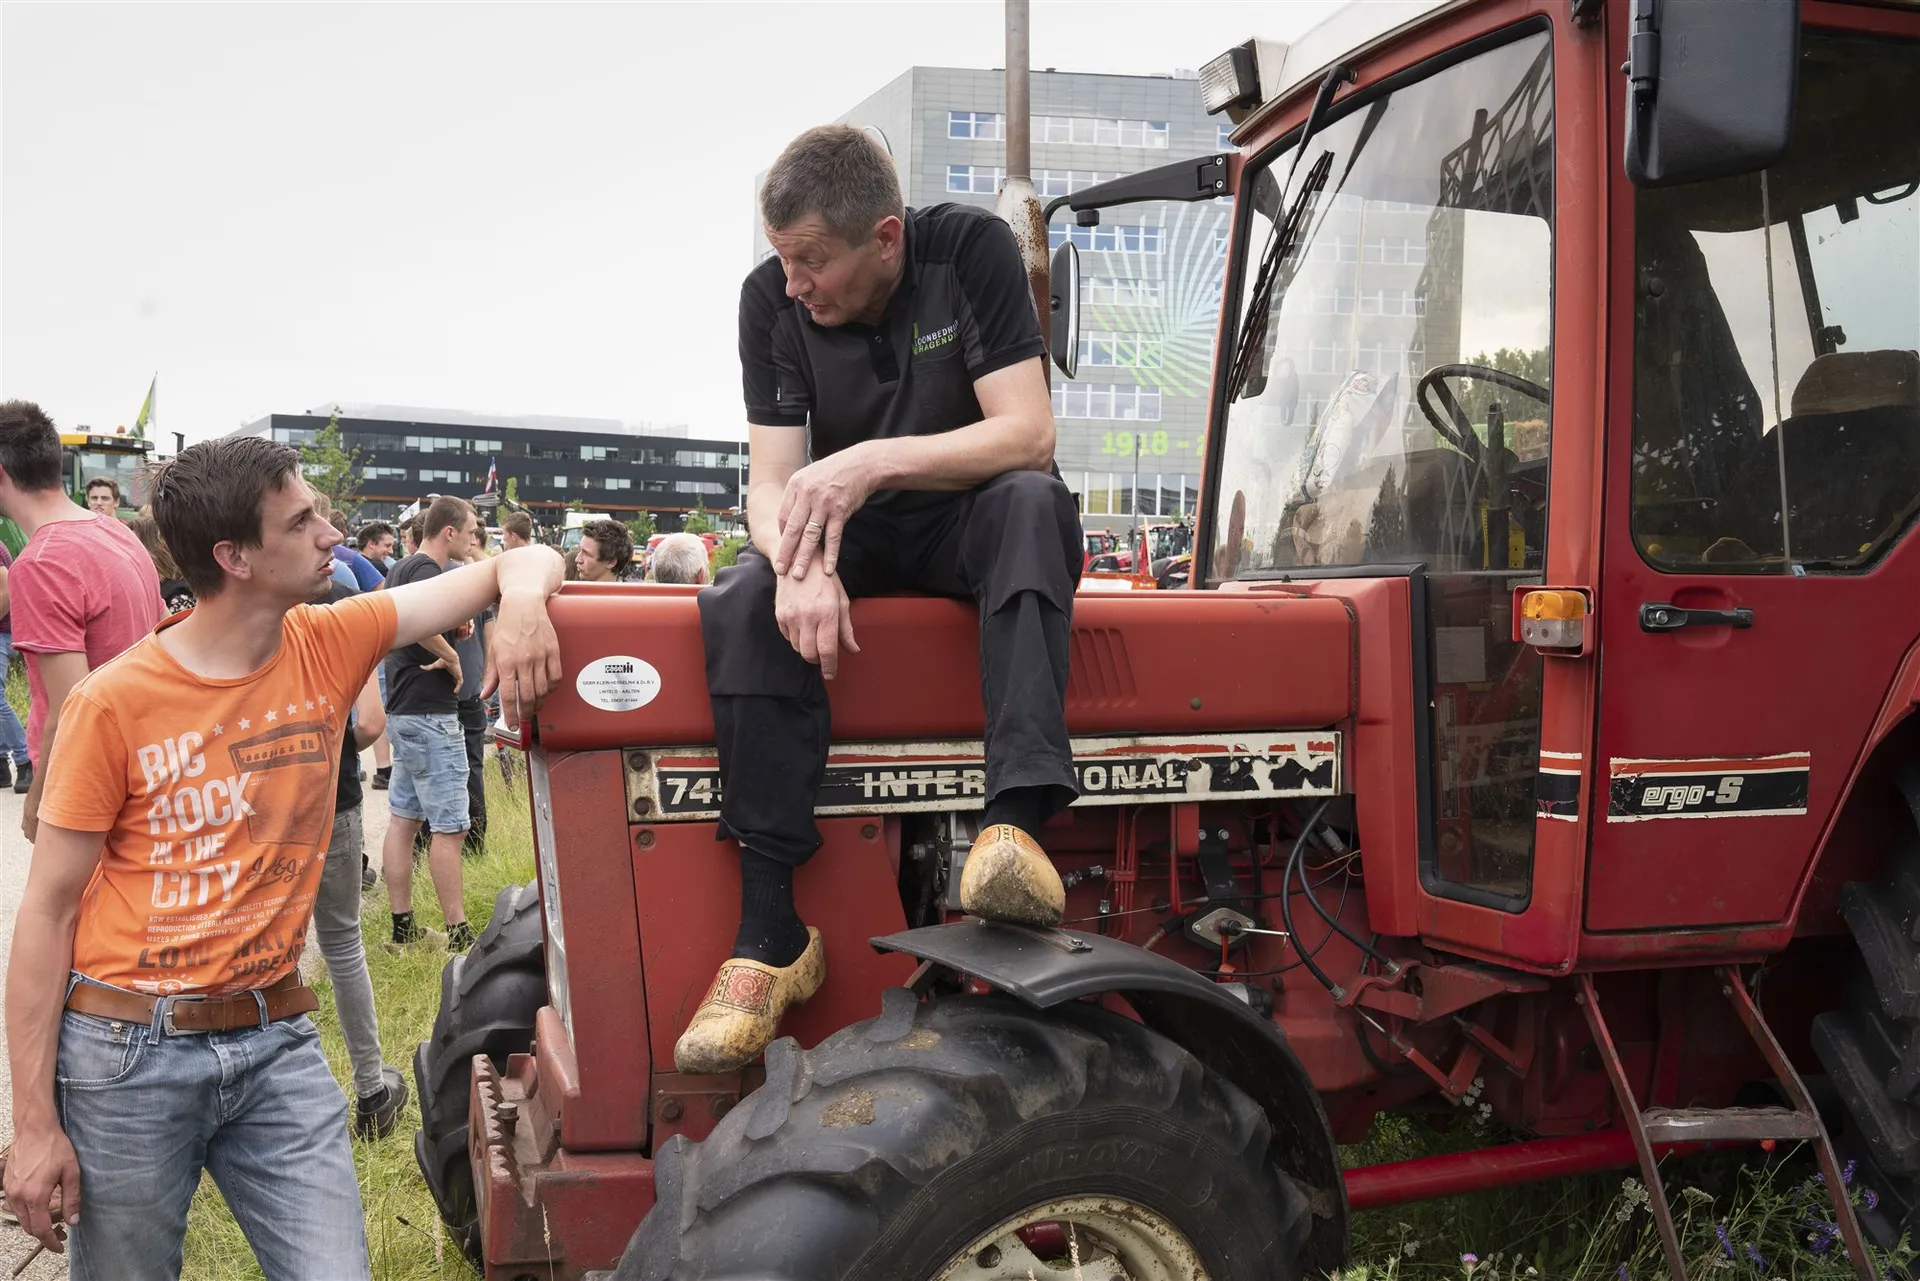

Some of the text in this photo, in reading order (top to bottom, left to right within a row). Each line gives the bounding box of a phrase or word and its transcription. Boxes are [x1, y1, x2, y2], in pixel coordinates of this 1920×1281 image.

[1101, 429, 1169, 457] 1918
[137, 731, 206, 794] BIG
[147, 771, 257, 835] ROCK
[150, 831, 227, 865] IN THE
[151, 860, 241, 909] CITY
[223, 914, 251, 926] RELIABLE
